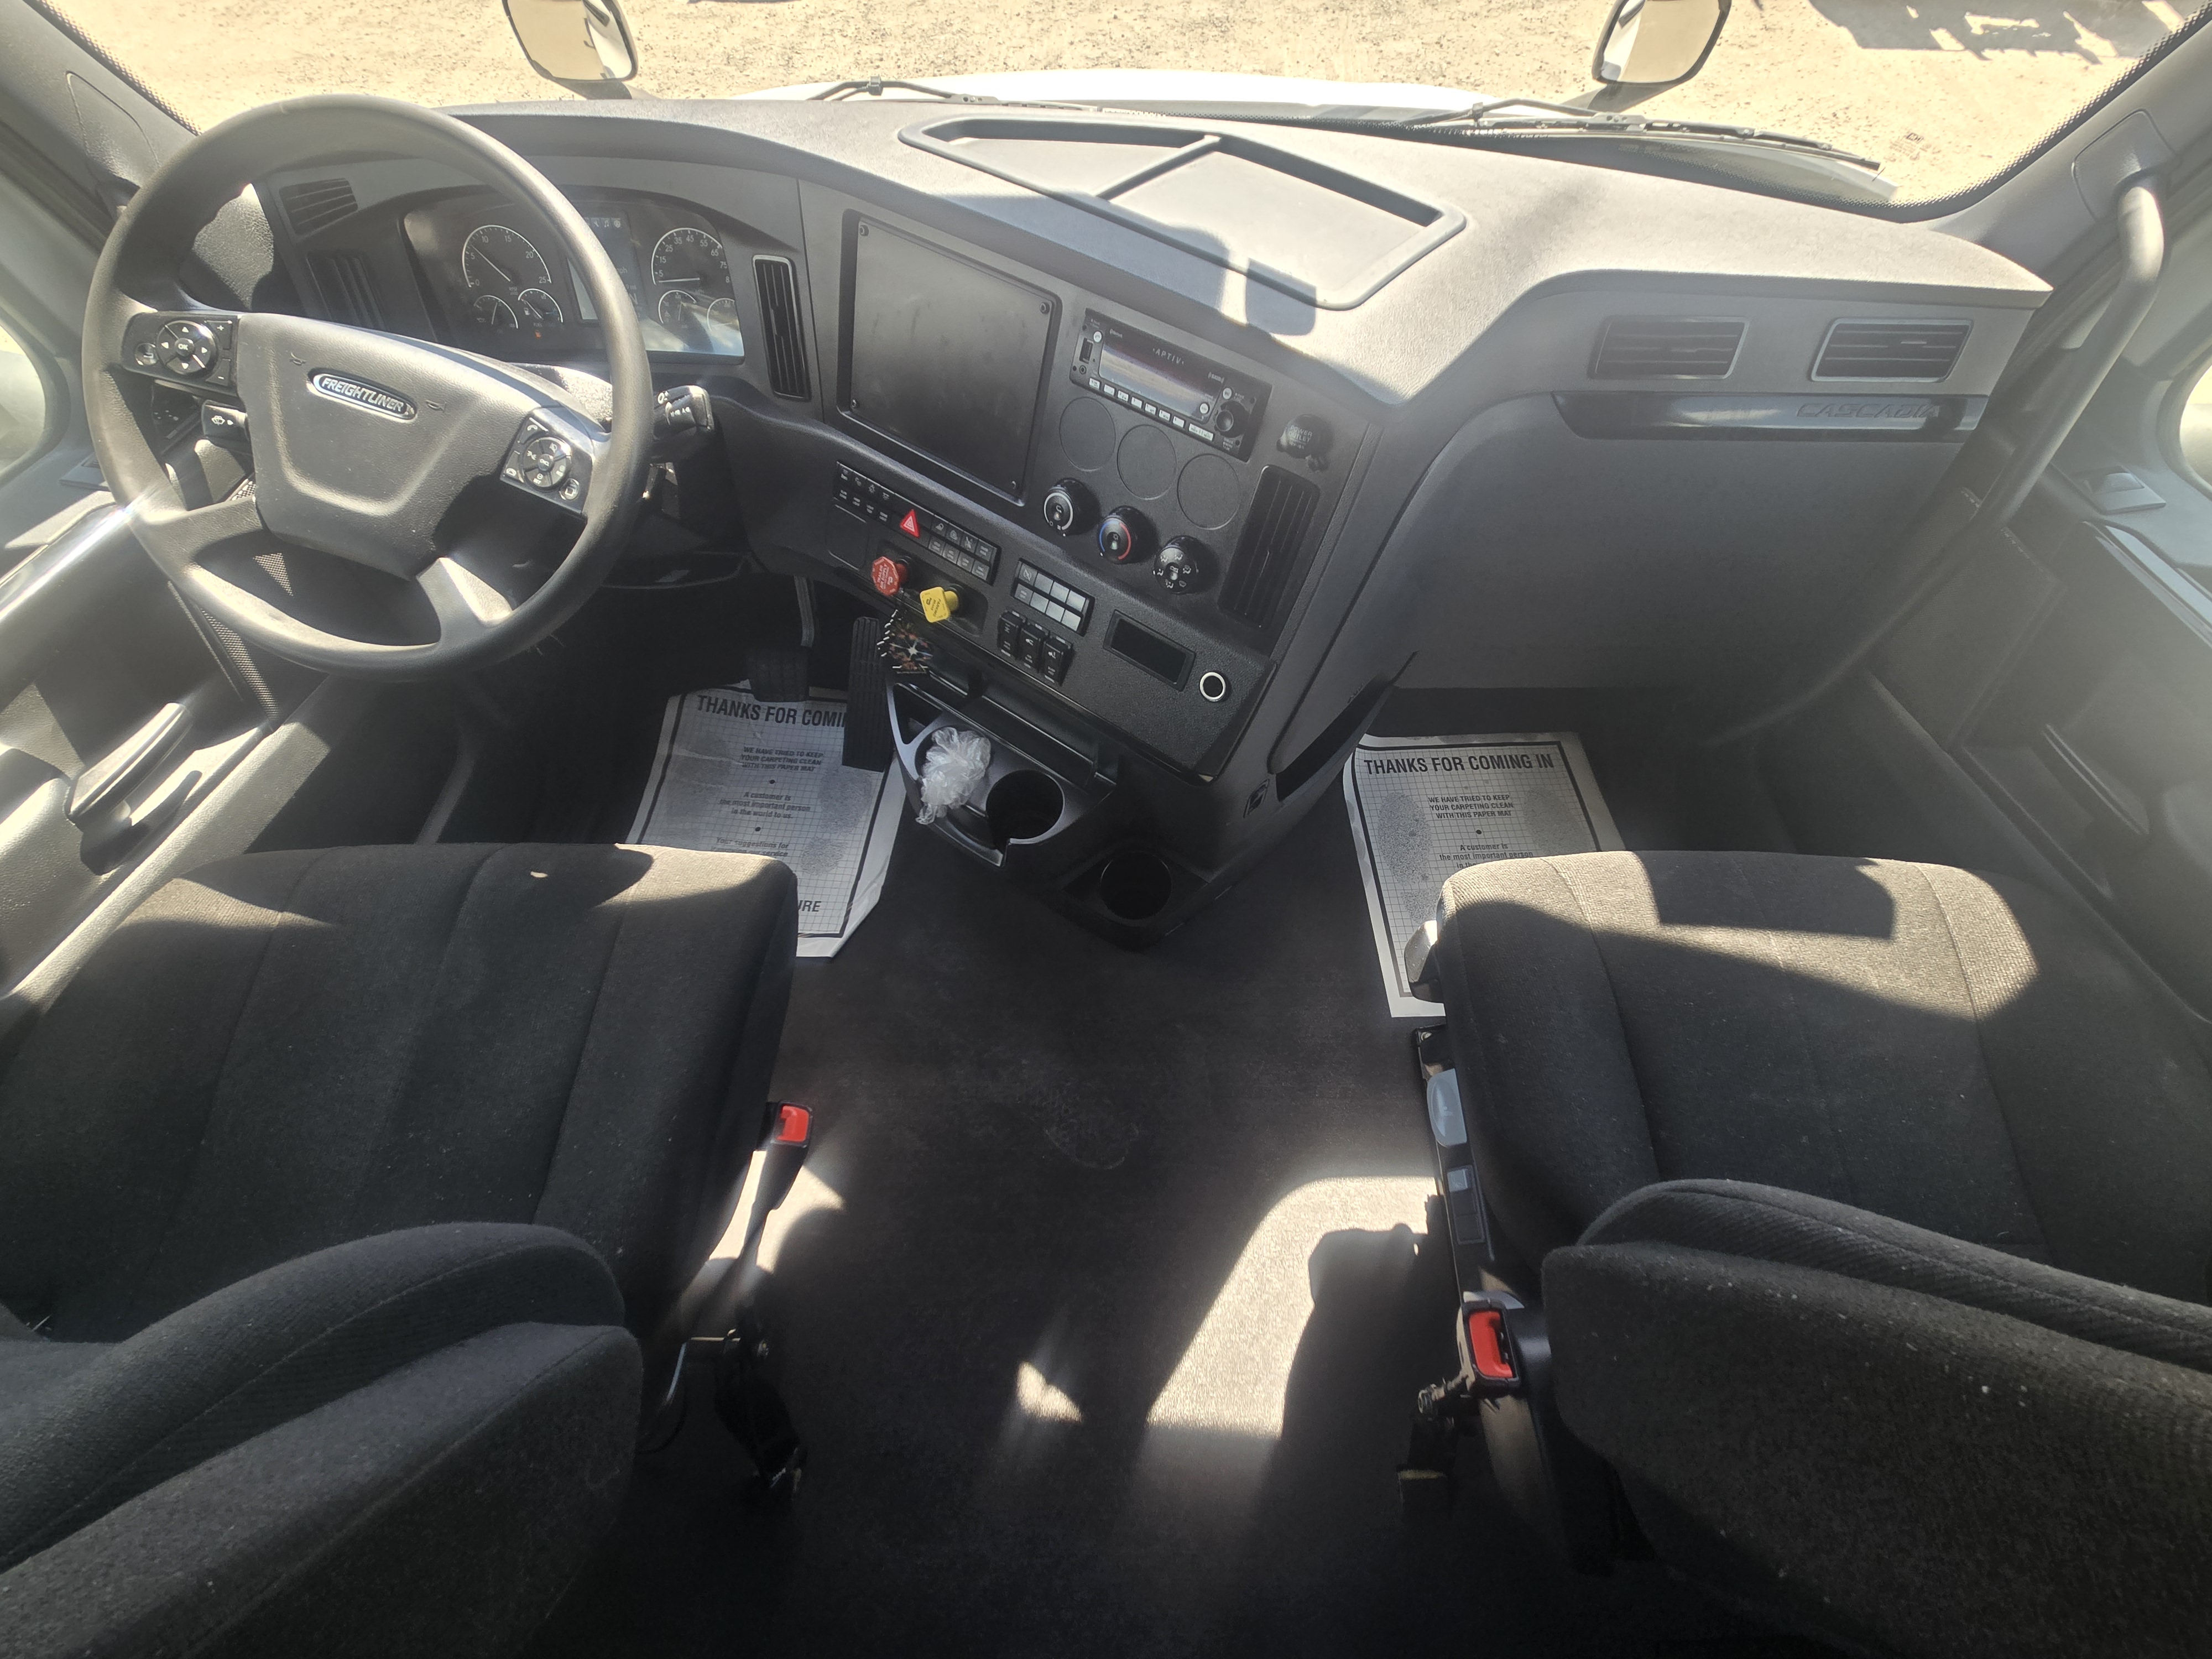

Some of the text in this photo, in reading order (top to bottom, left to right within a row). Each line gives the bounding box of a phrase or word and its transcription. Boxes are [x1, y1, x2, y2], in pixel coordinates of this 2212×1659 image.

[1155, 348, 1182, 364] APTIV
[321, 377, 404, 412] FREIGHTLINER
[1797, 403, 1940, 418] CASCADIA
[1288, 431, 1311, 442] OUTLET
[1290, 425, 1313, 437] POWER
[698, 695, 761, 721] THANKS
[765, 706, 797, 725] FOR
[760, 756, 797, 764] CARPETING
[1364, 754, 1554, 775] THANKS FOR COMING IN
[750, 792, 783, 801] customer
[752, 801, 785, 810] important
[735, 839, 777, 848] suggestions
[1473, 852, 1507, 860] important
